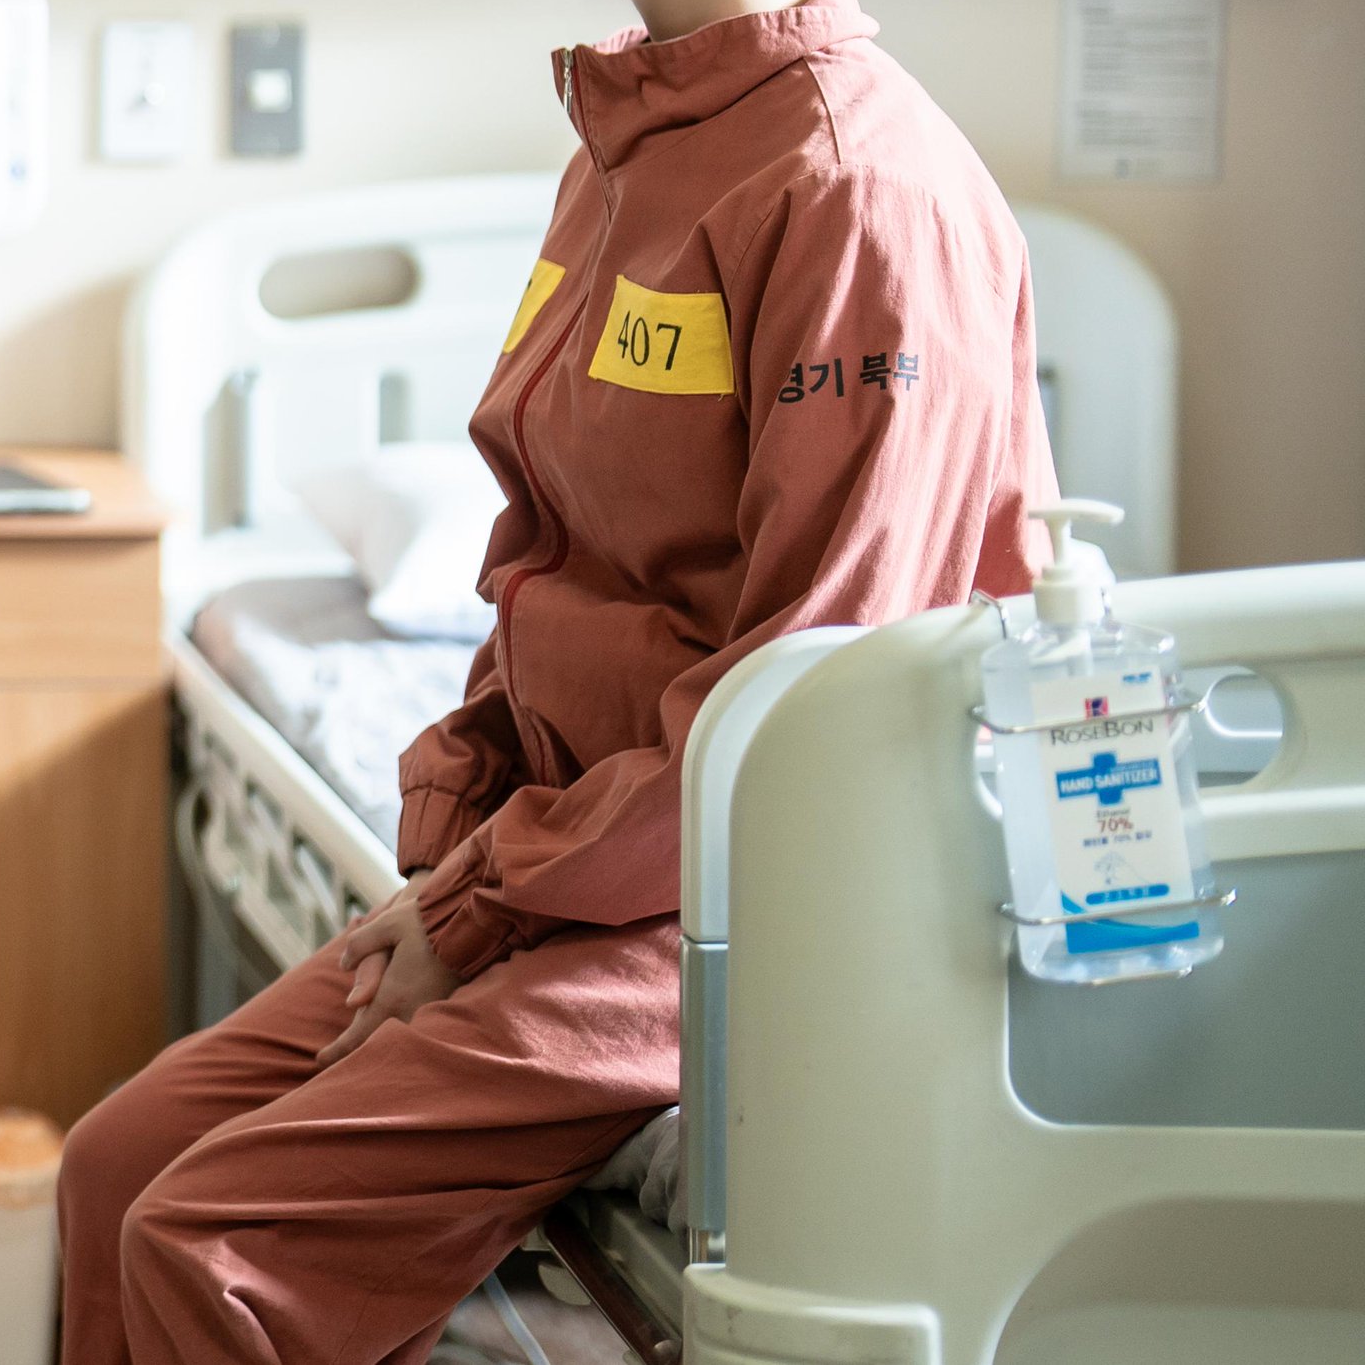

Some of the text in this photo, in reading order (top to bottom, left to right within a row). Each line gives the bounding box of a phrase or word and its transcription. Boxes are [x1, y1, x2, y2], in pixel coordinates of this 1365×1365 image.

[616, 310, 683, 371] 407
[860, 351, 920, 392] 북부
[1060, 766, 1158, 794] HAND SANITIZER
[1096, 816, 1134, 833] 70%
